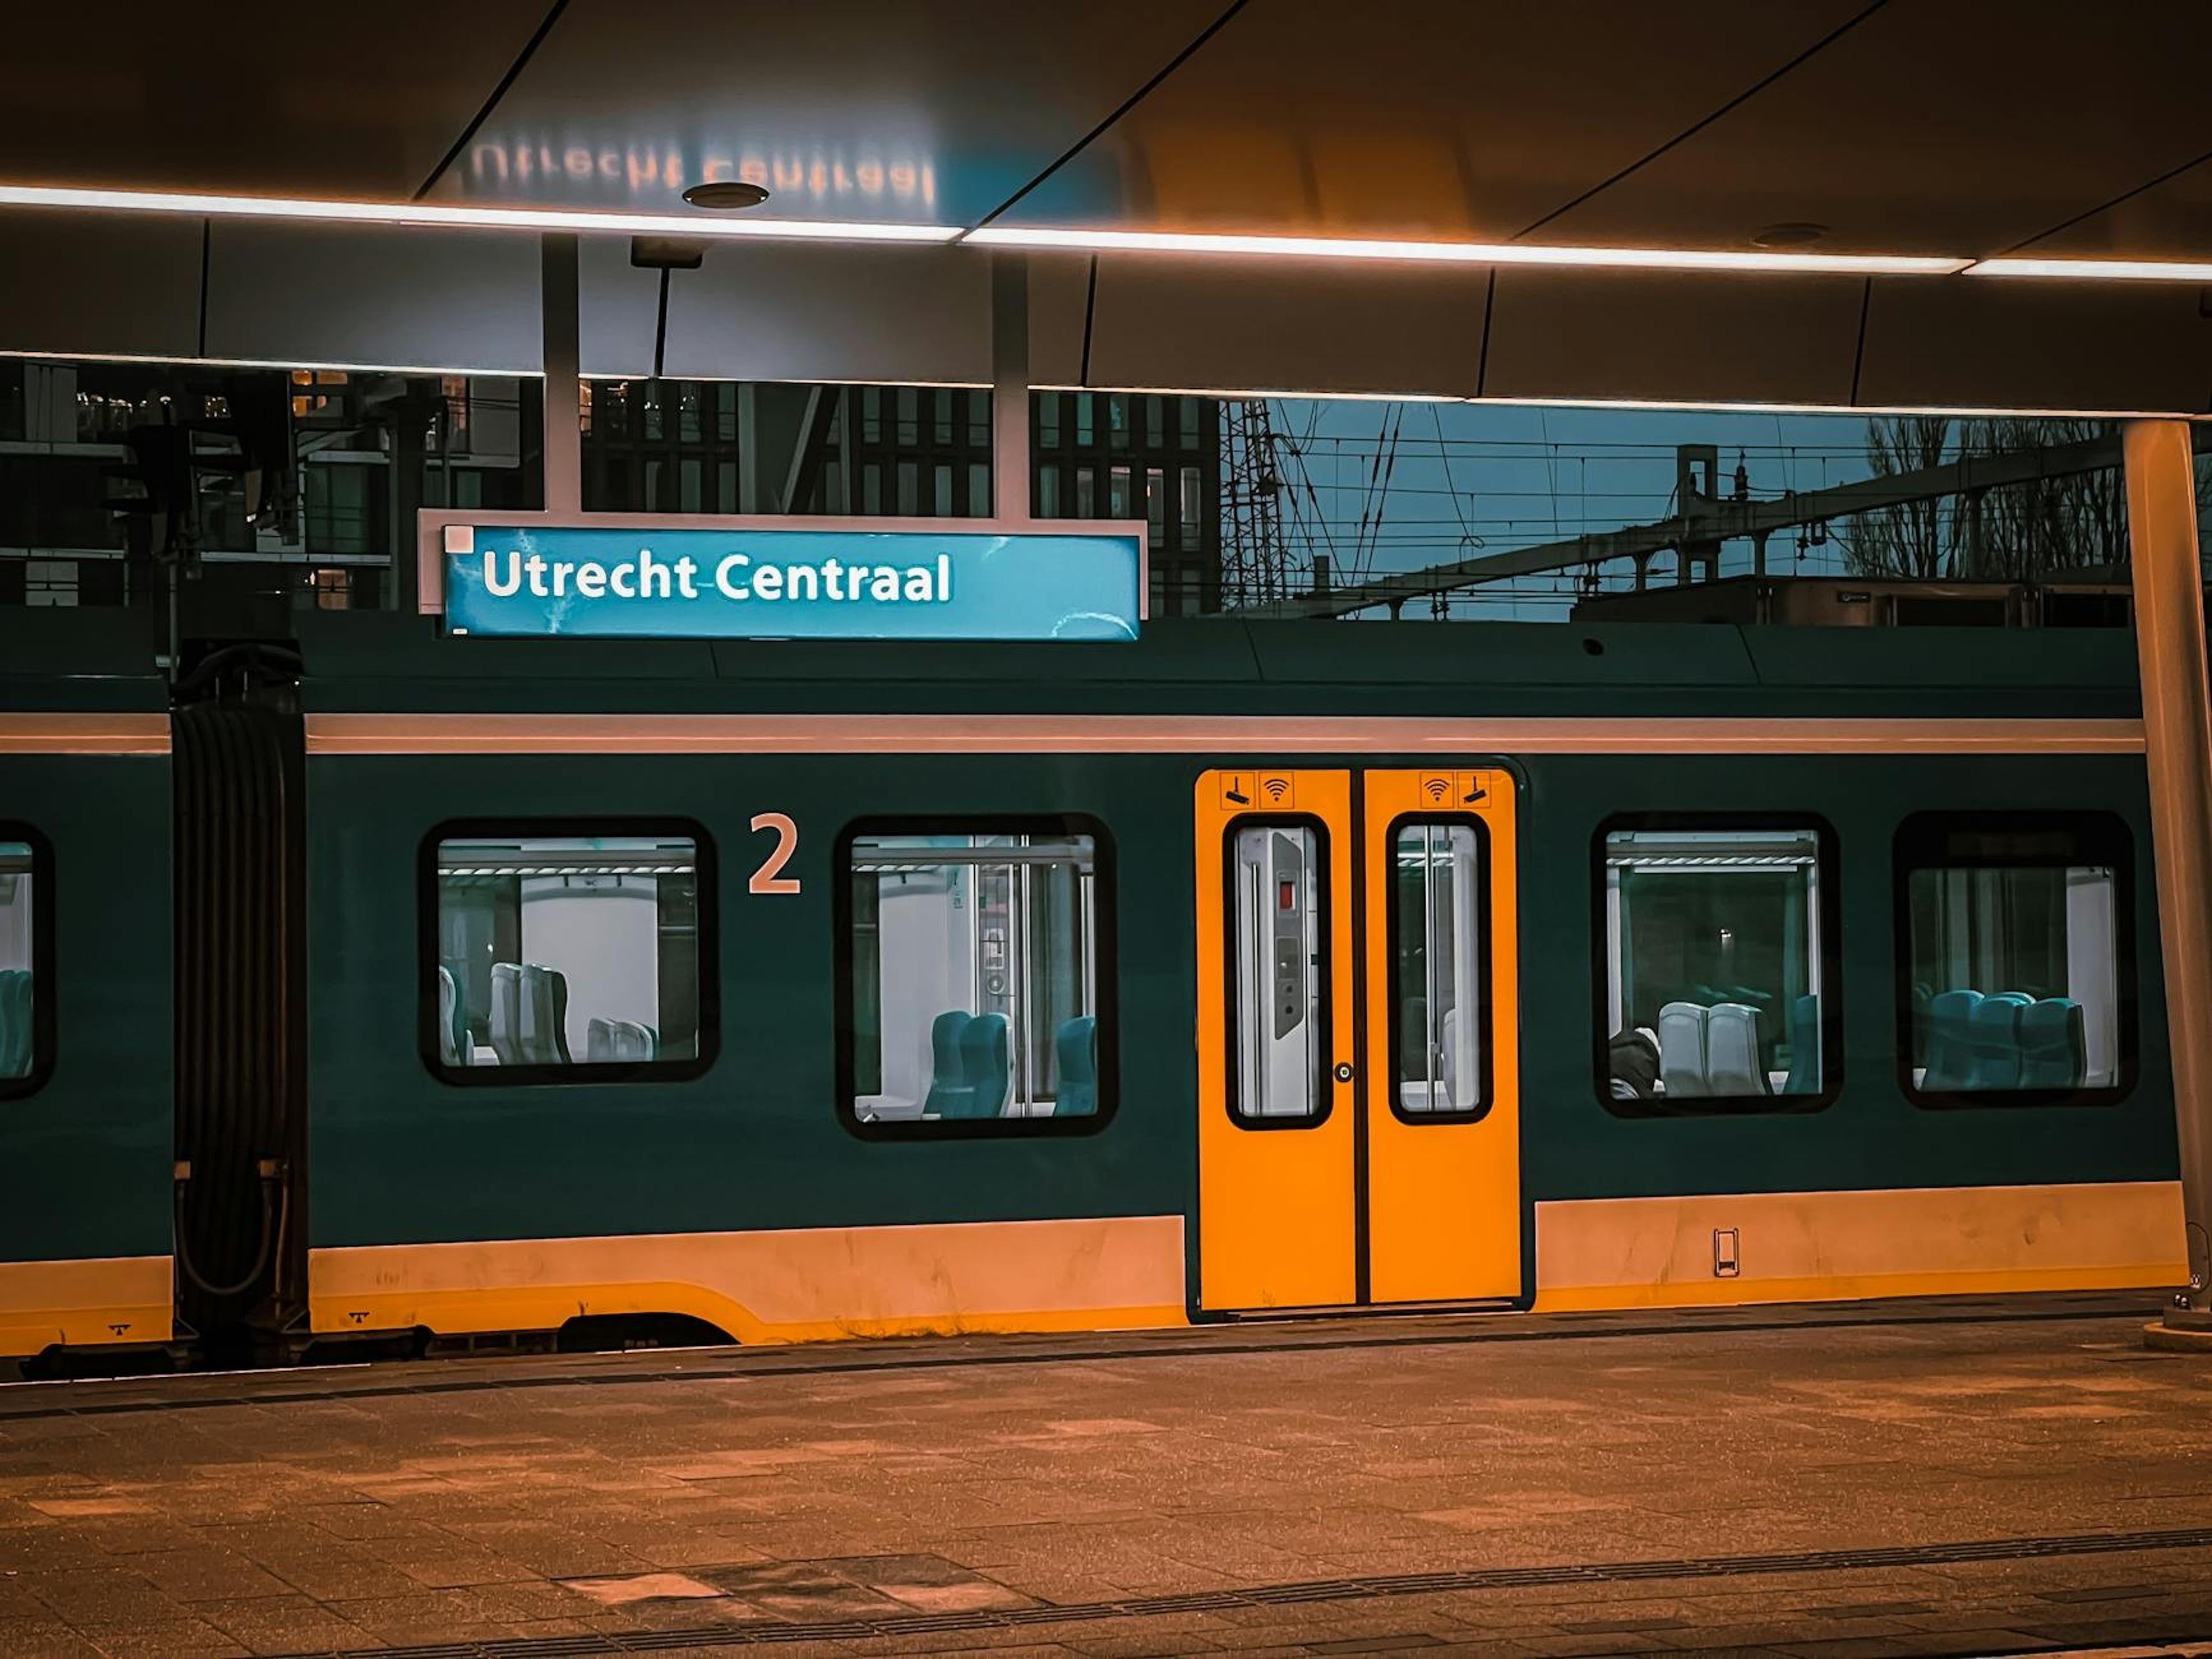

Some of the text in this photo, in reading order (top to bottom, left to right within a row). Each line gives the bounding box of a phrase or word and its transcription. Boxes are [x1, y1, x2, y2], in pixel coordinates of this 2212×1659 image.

[484, 550, 949, 602] Utrecht Centraal
[749, 813, 800, 893] 2
